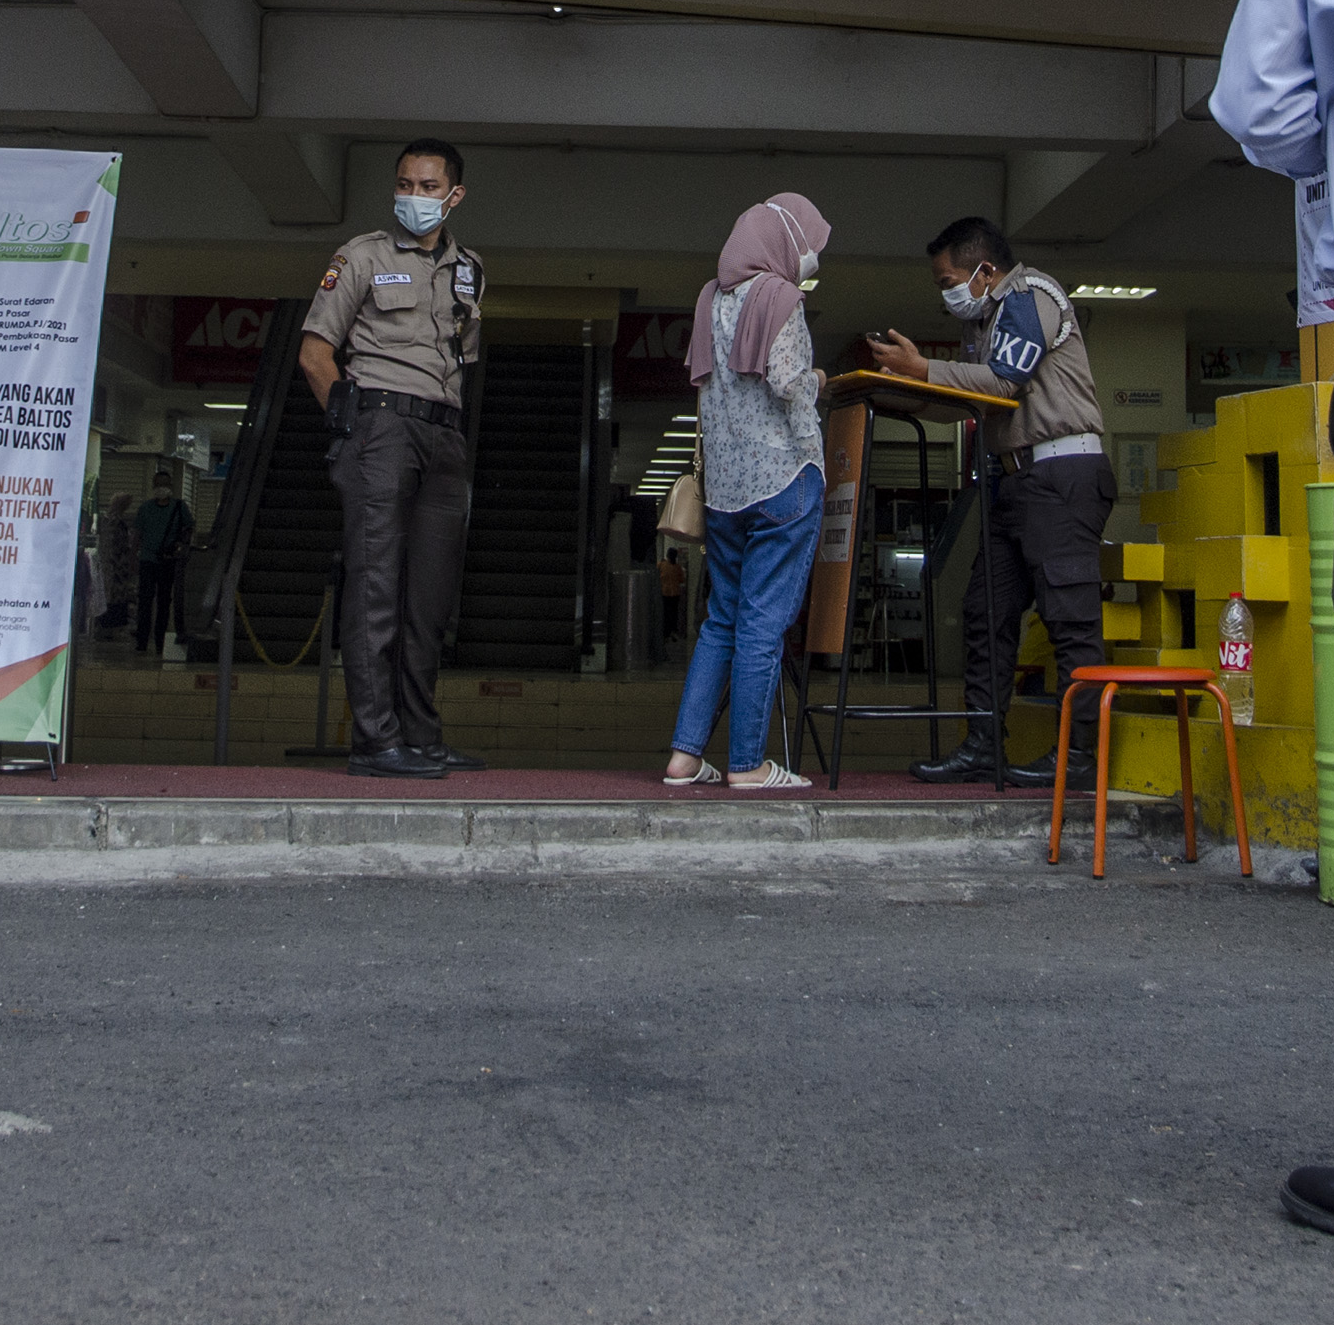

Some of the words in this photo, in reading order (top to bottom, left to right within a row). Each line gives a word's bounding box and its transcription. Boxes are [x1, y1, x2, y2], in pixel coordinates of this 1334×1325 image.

[25, 244, 65, 255] Square
[0, 297, 22, 306] Surat
[24, 297, 55, 306] Edaran
[6, 309, 31, 317] Pasar
[53, 334, 79, 343] Pasar
[627, 313, 694, 358] AC
[9, 343, 32, 352] Level
[33, 343, 40, 351] 4
[33, 386, 75, 406] AKAN
[16, 407, 72, 428] BALTOS
[12, 429, 66, 451] VAKSIN
[33, 600, 39, 608] 6
[41, 601, 50, 609] M
[1219, 641, 1250, 668] Vit
